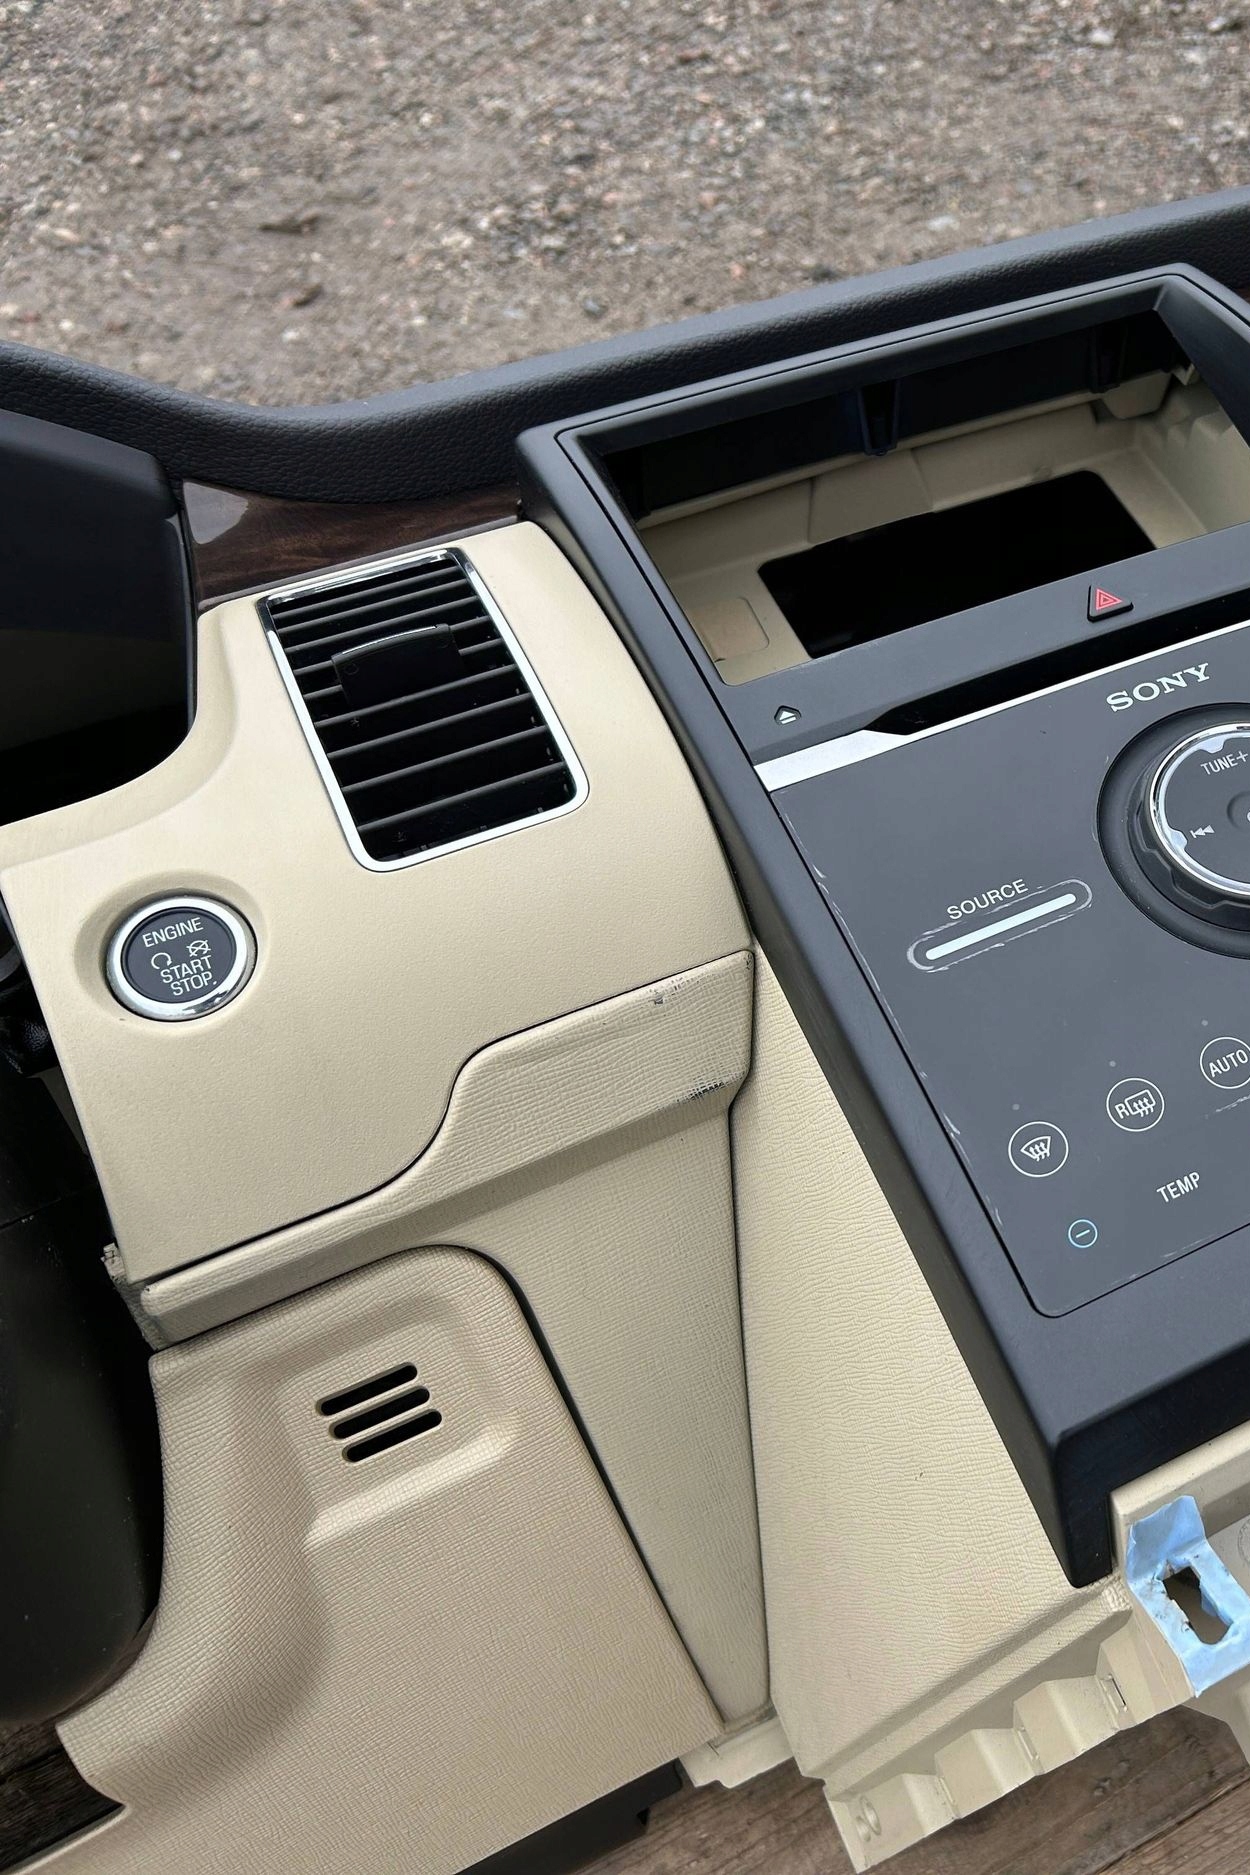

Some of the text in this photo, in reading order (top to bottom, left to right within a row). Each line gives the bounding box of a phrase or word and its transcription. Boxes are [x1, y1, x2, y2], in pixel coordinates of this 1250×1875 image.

[1106, 662, 1210, 712] SONY
[946, 878, 1029, 921] SOURCE
[142, 917, 203, 948] ENGINE
[160, 955, 212, 984] START
[170, 971, 213, 996] STOP
[1208, 1049, 1249, 1077] AUTO
[1156, 1171, 1202, 1204] TEMP
